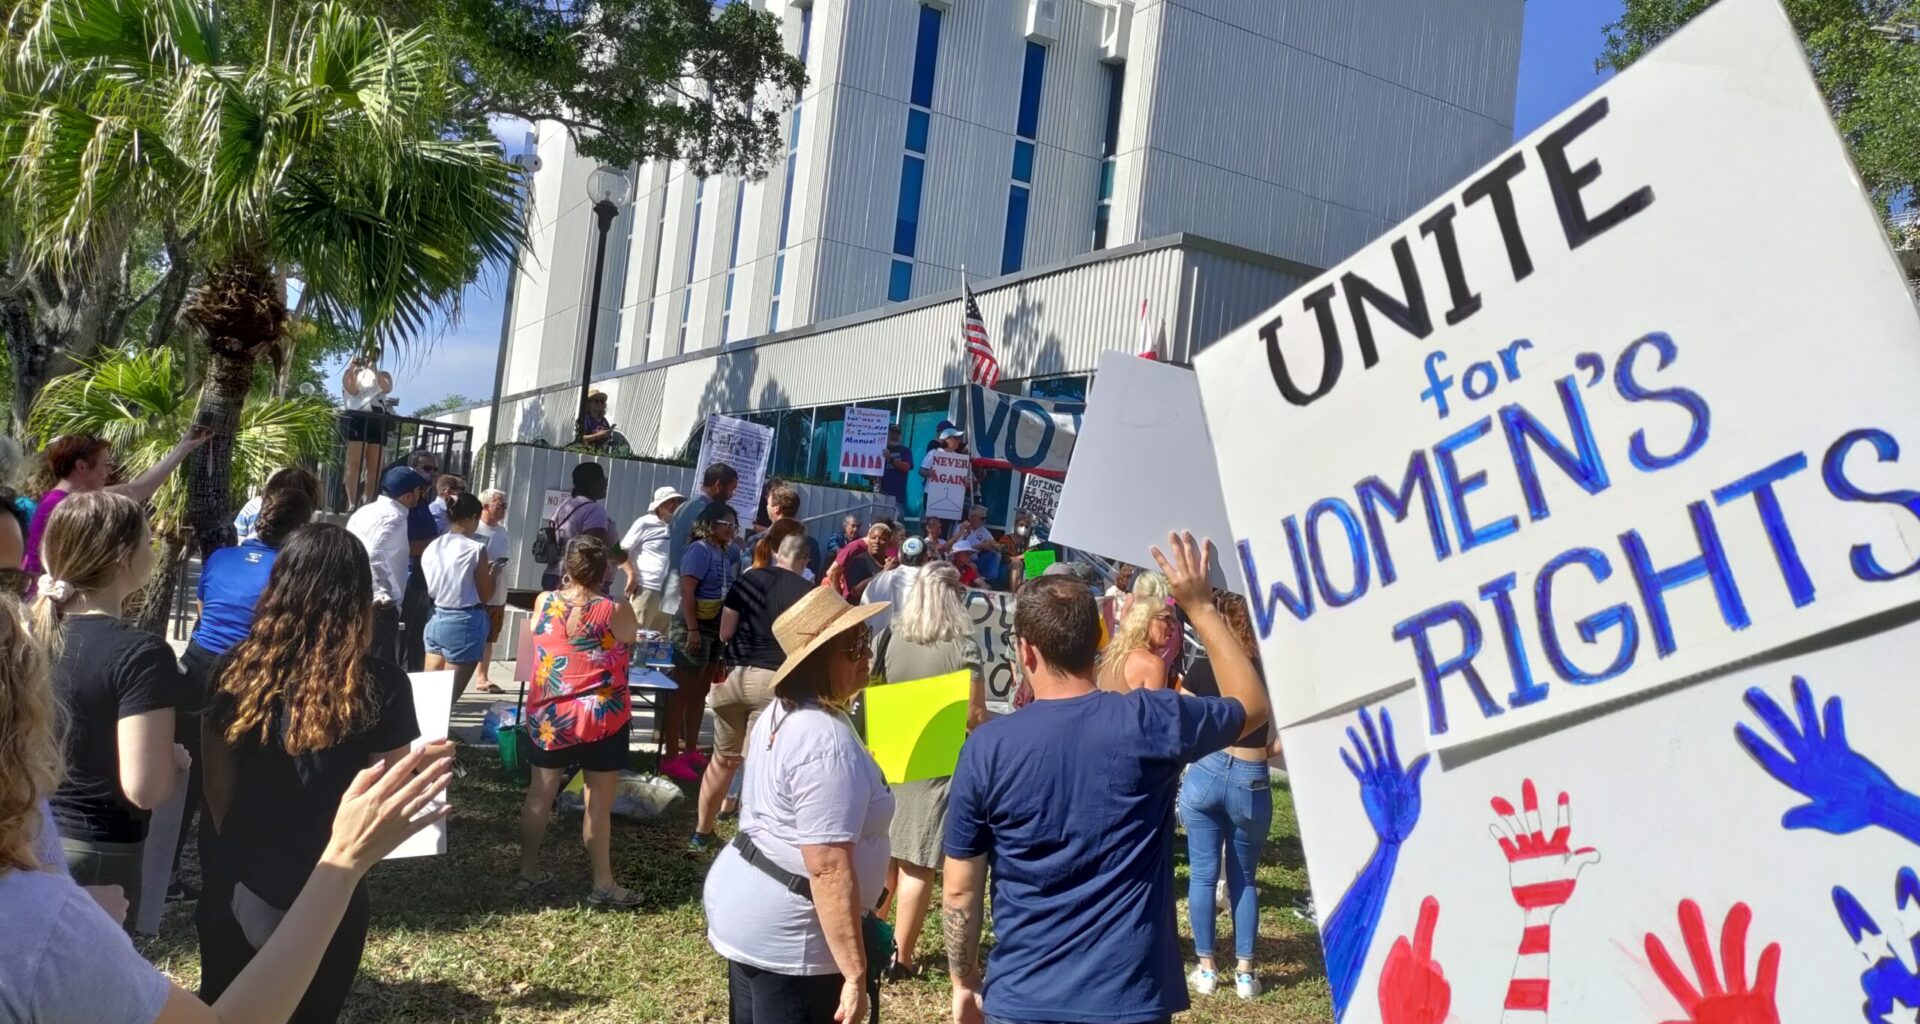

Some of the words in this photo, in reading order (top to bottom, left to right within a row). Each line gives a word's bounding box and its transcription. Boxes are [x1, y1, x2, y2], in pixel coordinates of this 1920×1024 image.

[1258, 96, 1656, 406] UNITE
[1419, 337, 1534, 418] for
[845, 436, 876, 445] Manual
[932, 455, 969, 469] NEVER
[930, 470, 967, 485] AGAIN
[1028, 474, 1063, 494] VOTING
[1238, 330, 1711, 640] WOMEN'S
[1024, 486, 1037, 495] IS
[1039, 489, 1055, 499] THE
[547, 495, 559, 506] NO
[1023, 493, 1054, 508] POWER
[1392, 427, 1920, 735] RIGHTS
